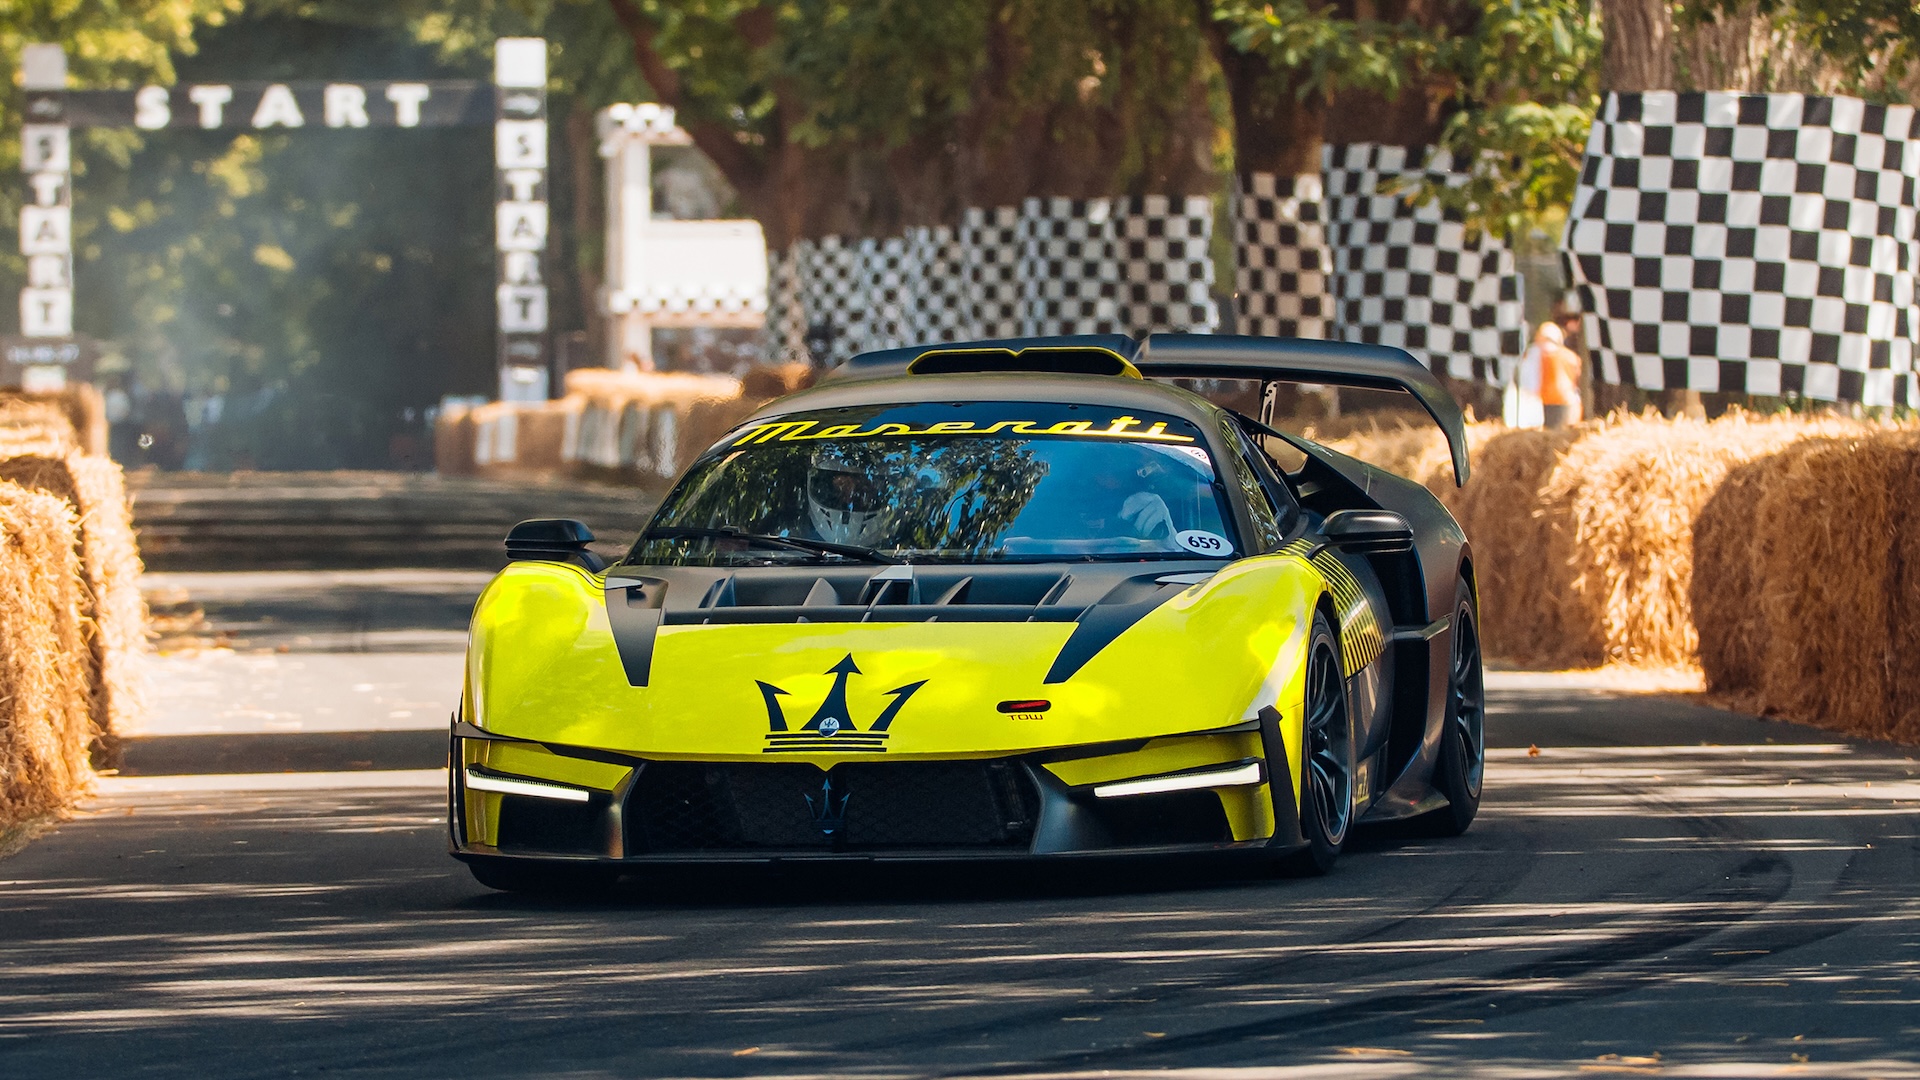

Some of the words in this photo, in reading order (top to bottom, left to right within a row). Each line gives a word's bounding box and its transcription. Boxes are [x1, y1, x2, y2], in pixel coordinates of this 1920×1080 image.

[134, 84, 430, 130] START
[28, 134, 67, 324] START
[503, 134, 542, 320] START
[732, 416, 1195, 447] Maserati
[1187, 535, 1221, 550] 659
